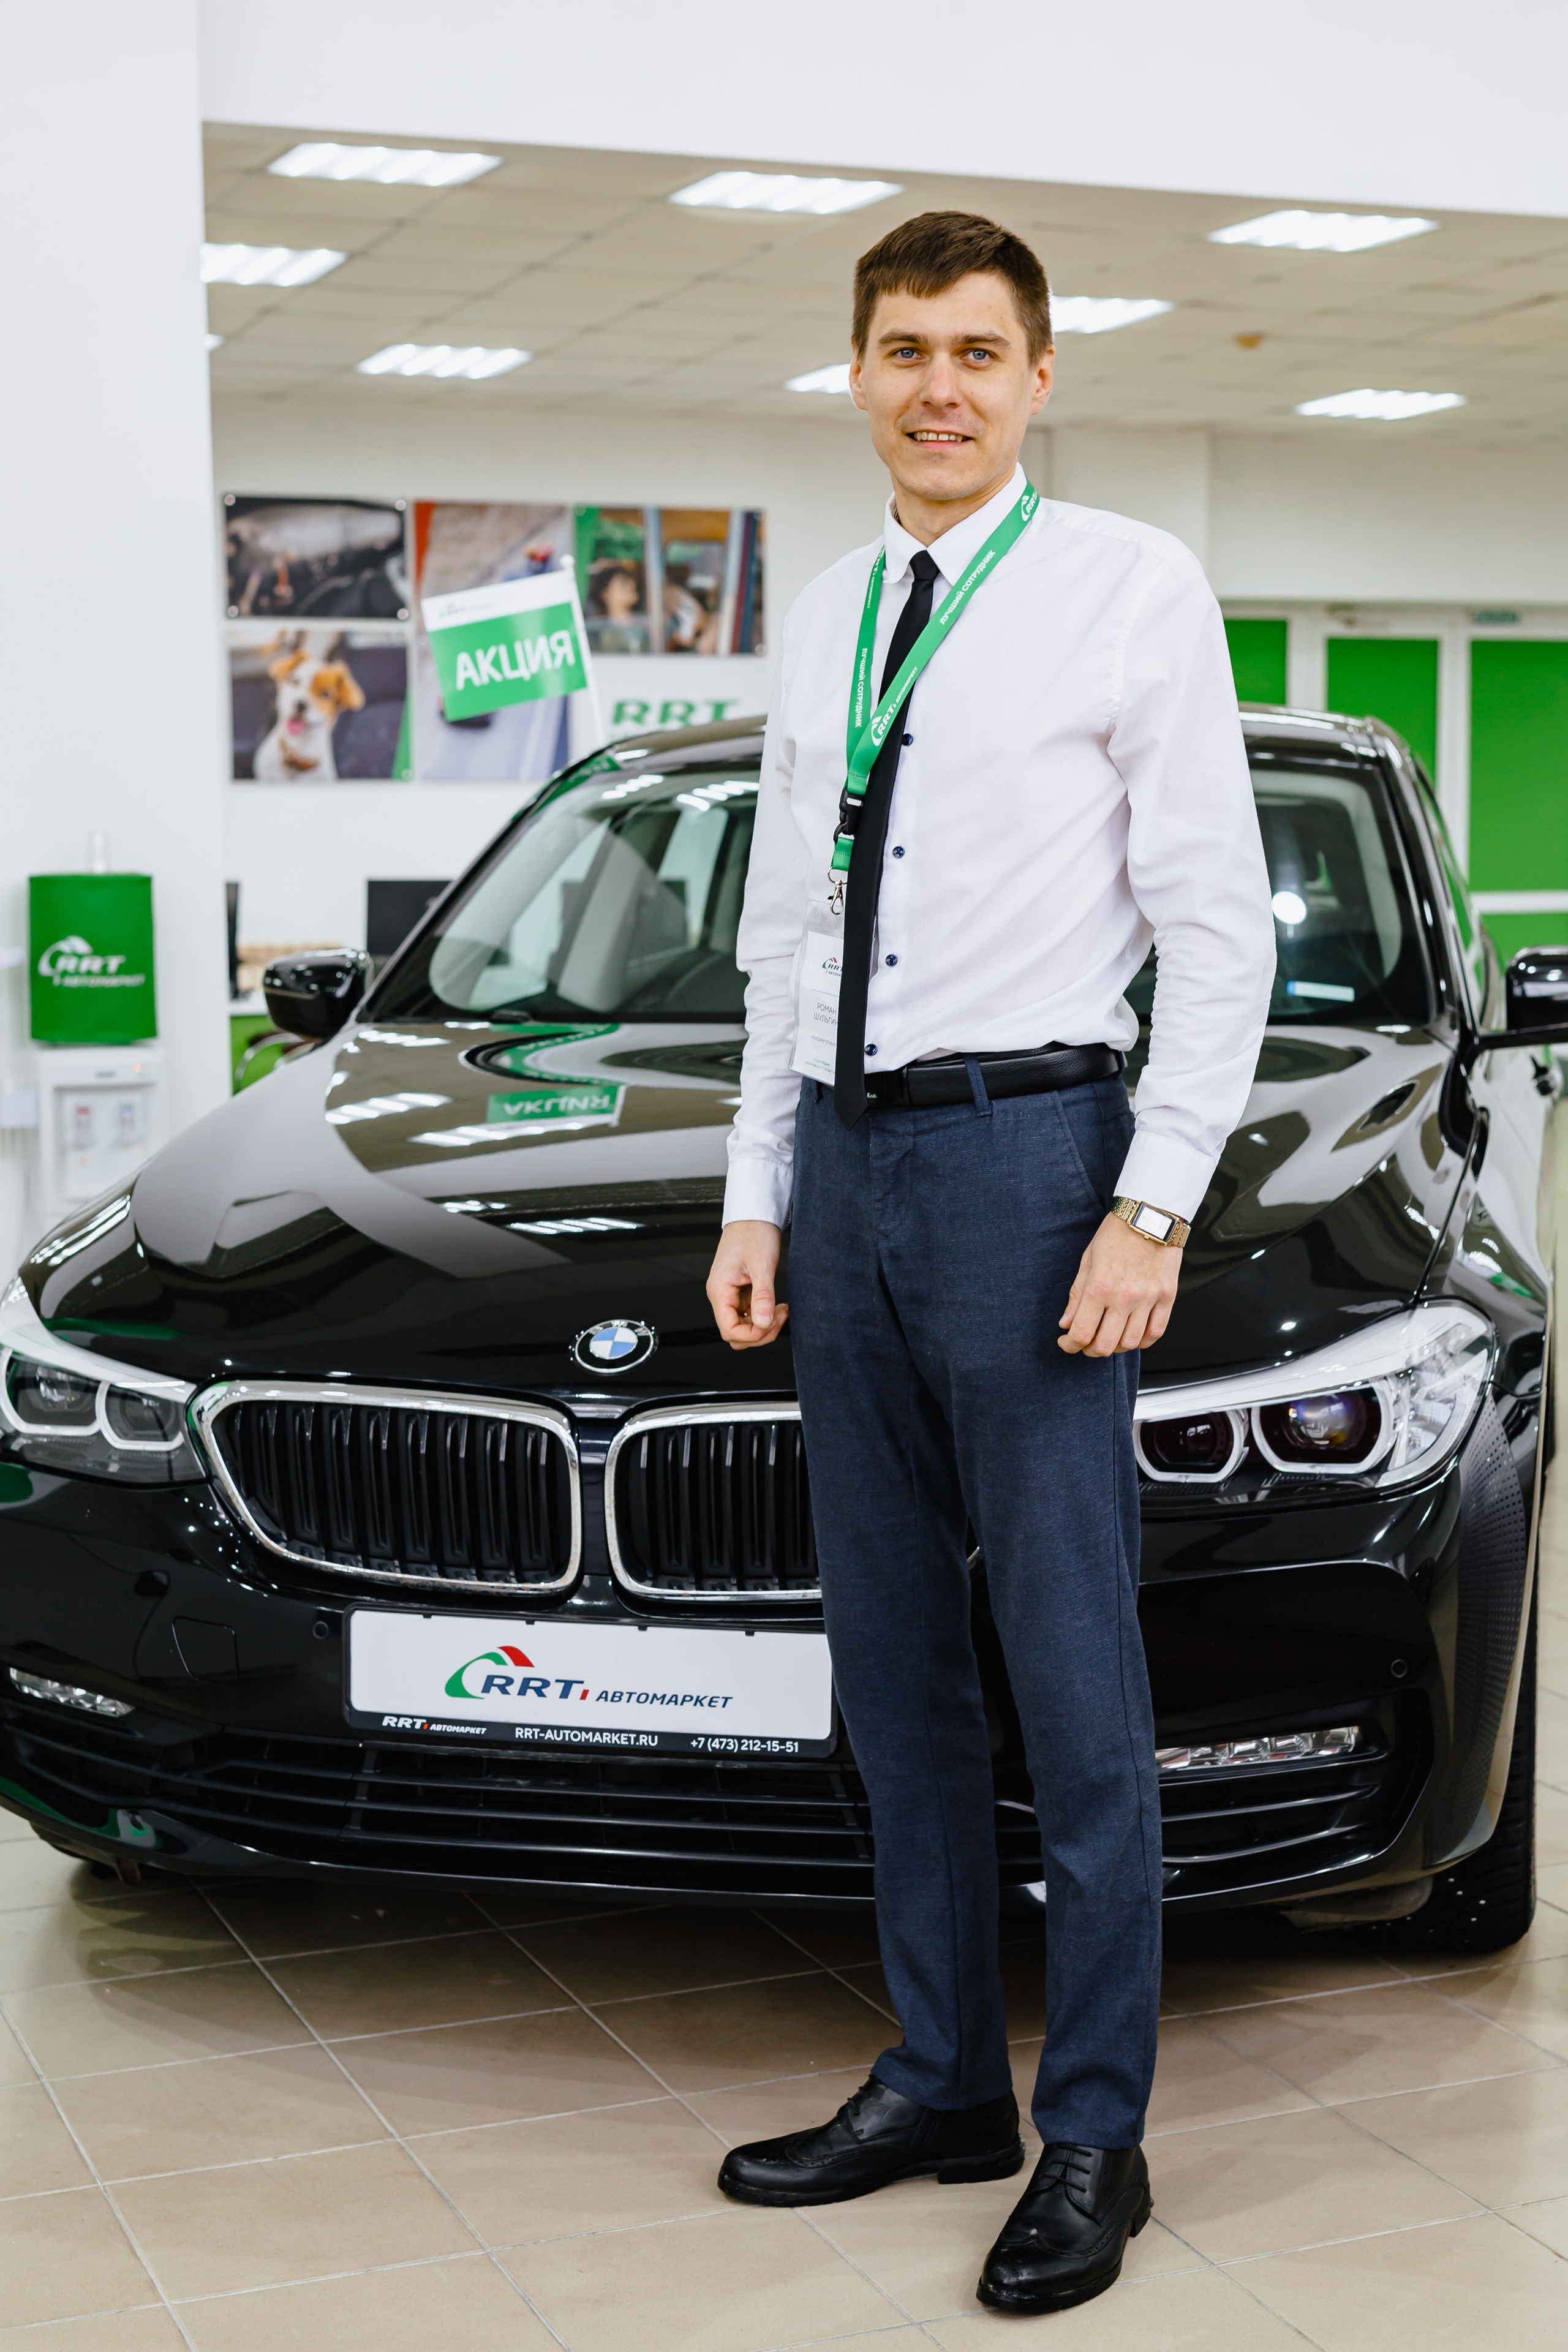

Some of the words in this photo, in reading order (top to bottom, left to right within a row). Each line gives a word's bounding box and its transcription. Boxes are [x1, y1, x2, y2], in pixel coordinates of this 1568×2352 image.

[940, 590, 965, 625] ЛУЧШИЙ
[962, 549, 996, 591] СОТРУДНИК
[456, 630, 575, 691] АКЦИЯ
[859, 647, 868, 681] ЛУЧШИЙ
[612, 699, 739, 727] RRT
[855, 680, 864, 728] СОТРУДНИК
[877, 704, 894, 736] RRT
[895, 666, 918, 703] АВТОМАРКЕТ
[55, 955, 126, 974] RRT
[816, 1002, 837, 1016] РОМАН
[481, 1675, 584, 1699] RRT
[595, 1690, 733, 1708] АВТОМАРКЕТ
[382, 1716, 426, 1730] RRT
[429, 1723, 487, 1735] АВТОМАРКЕТ
[515, 1727, 658, 1747] RRT-AUTOMARKET.RU
[690, 1738, 705, 1749] +7
[707, 1738, 738, 1752] (473)
[741, 1739, 799, 1753] 212-15-51
